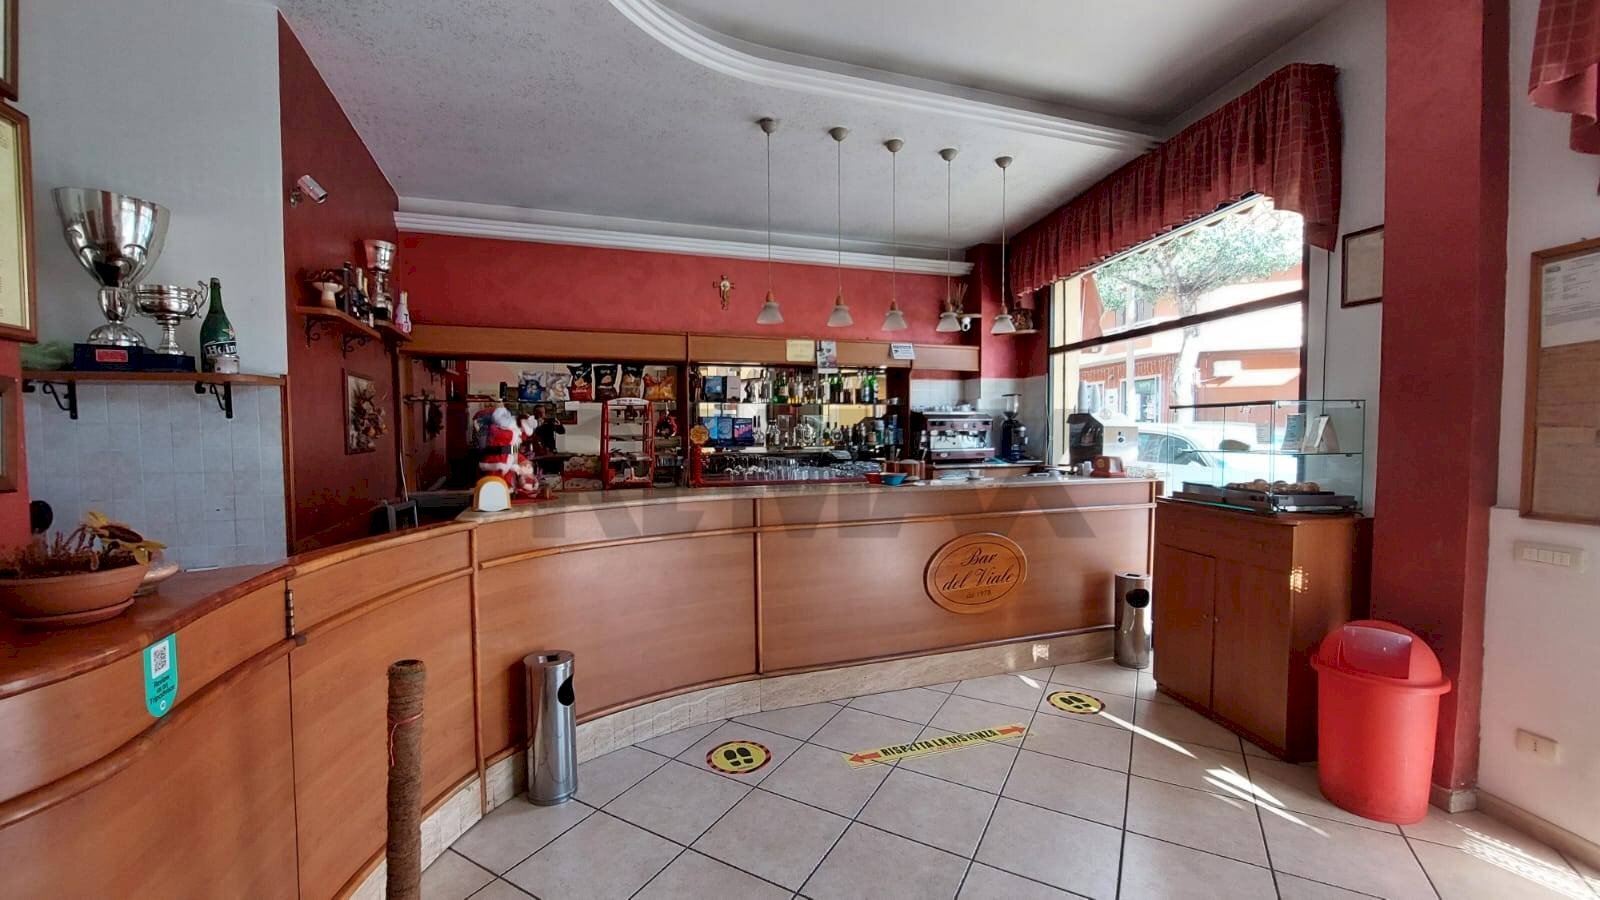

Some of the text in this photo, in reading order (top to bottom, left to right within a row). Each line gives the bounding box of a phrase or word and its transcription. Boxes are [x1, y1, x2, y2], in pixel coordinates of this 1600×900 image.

[961, 549, 998, 566] Bar
[942, 564, 1015, 591] del Viale
[880, 739, 934, 757] RISPETTA
[932, 737, 947, 748] LA
[946, 729, 998, 745] DISTANZA
